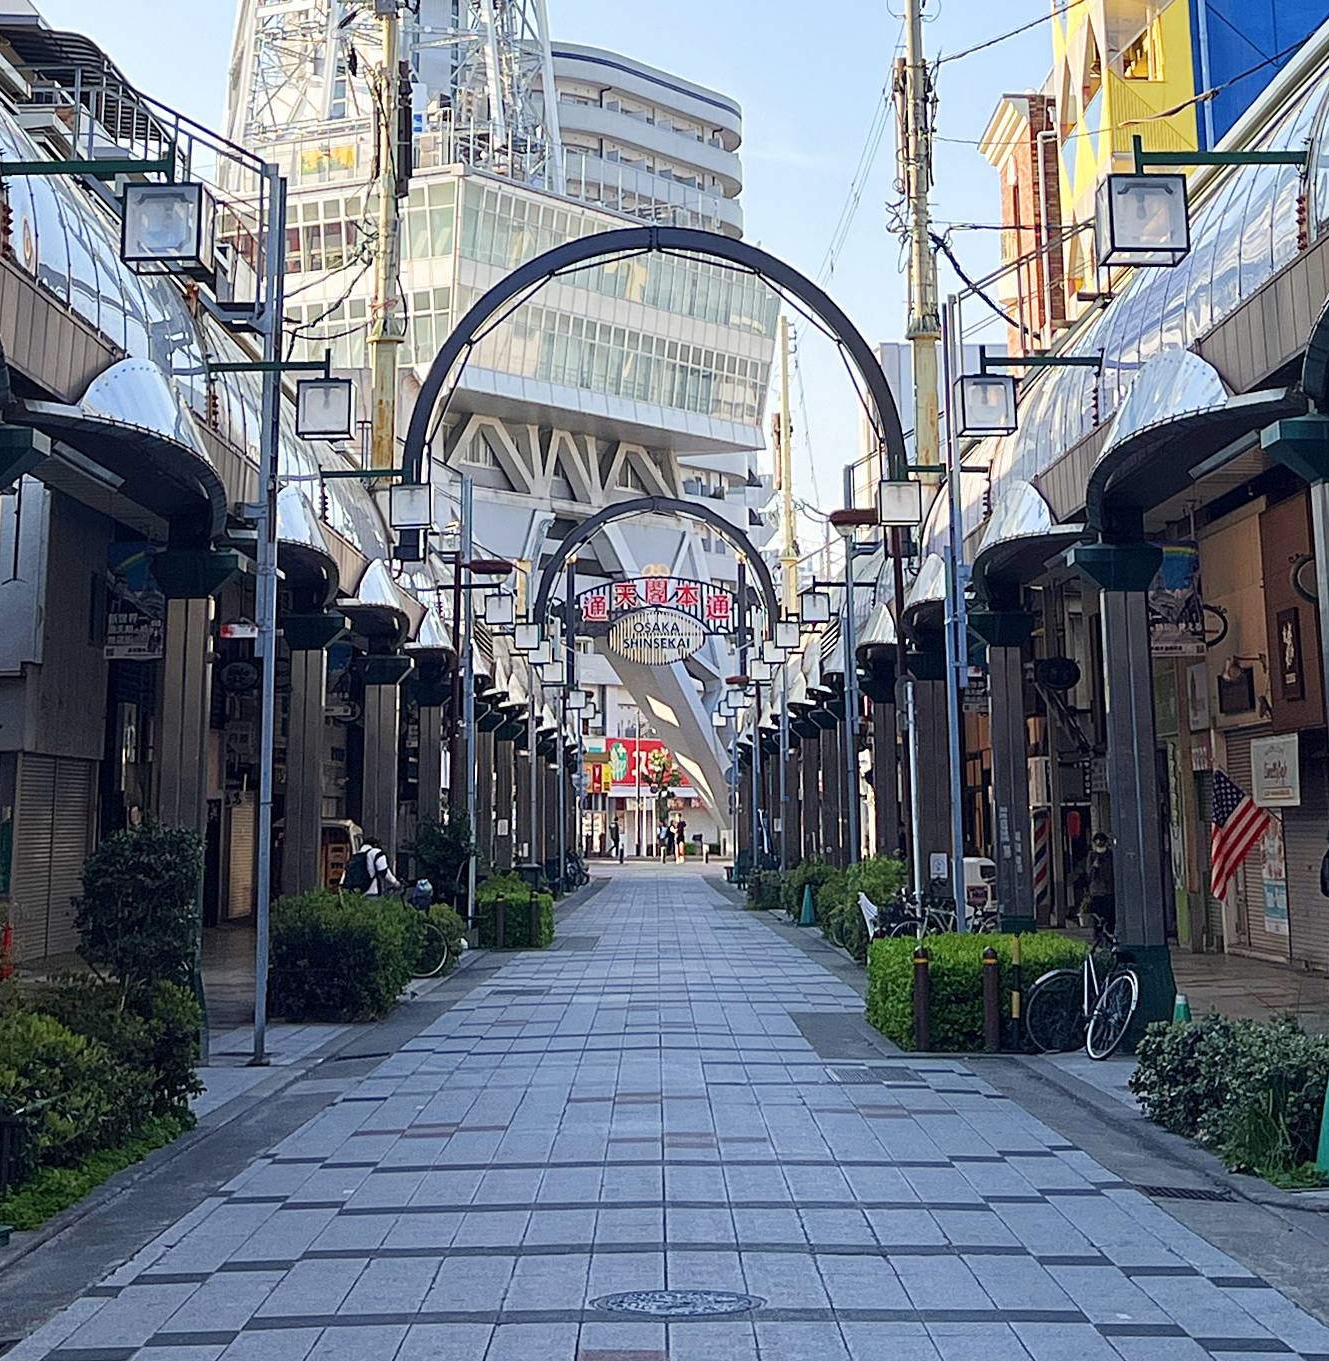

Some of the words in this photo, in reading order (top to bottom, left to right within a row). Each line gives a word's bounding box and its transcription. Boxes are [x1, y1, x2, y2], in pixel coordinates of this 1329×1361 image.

[582, 578, 731, 621] 通天閣本通
[633, 622, 680, 633] OSAKA
[623, 637, 691, 649] SHINSEKAI
